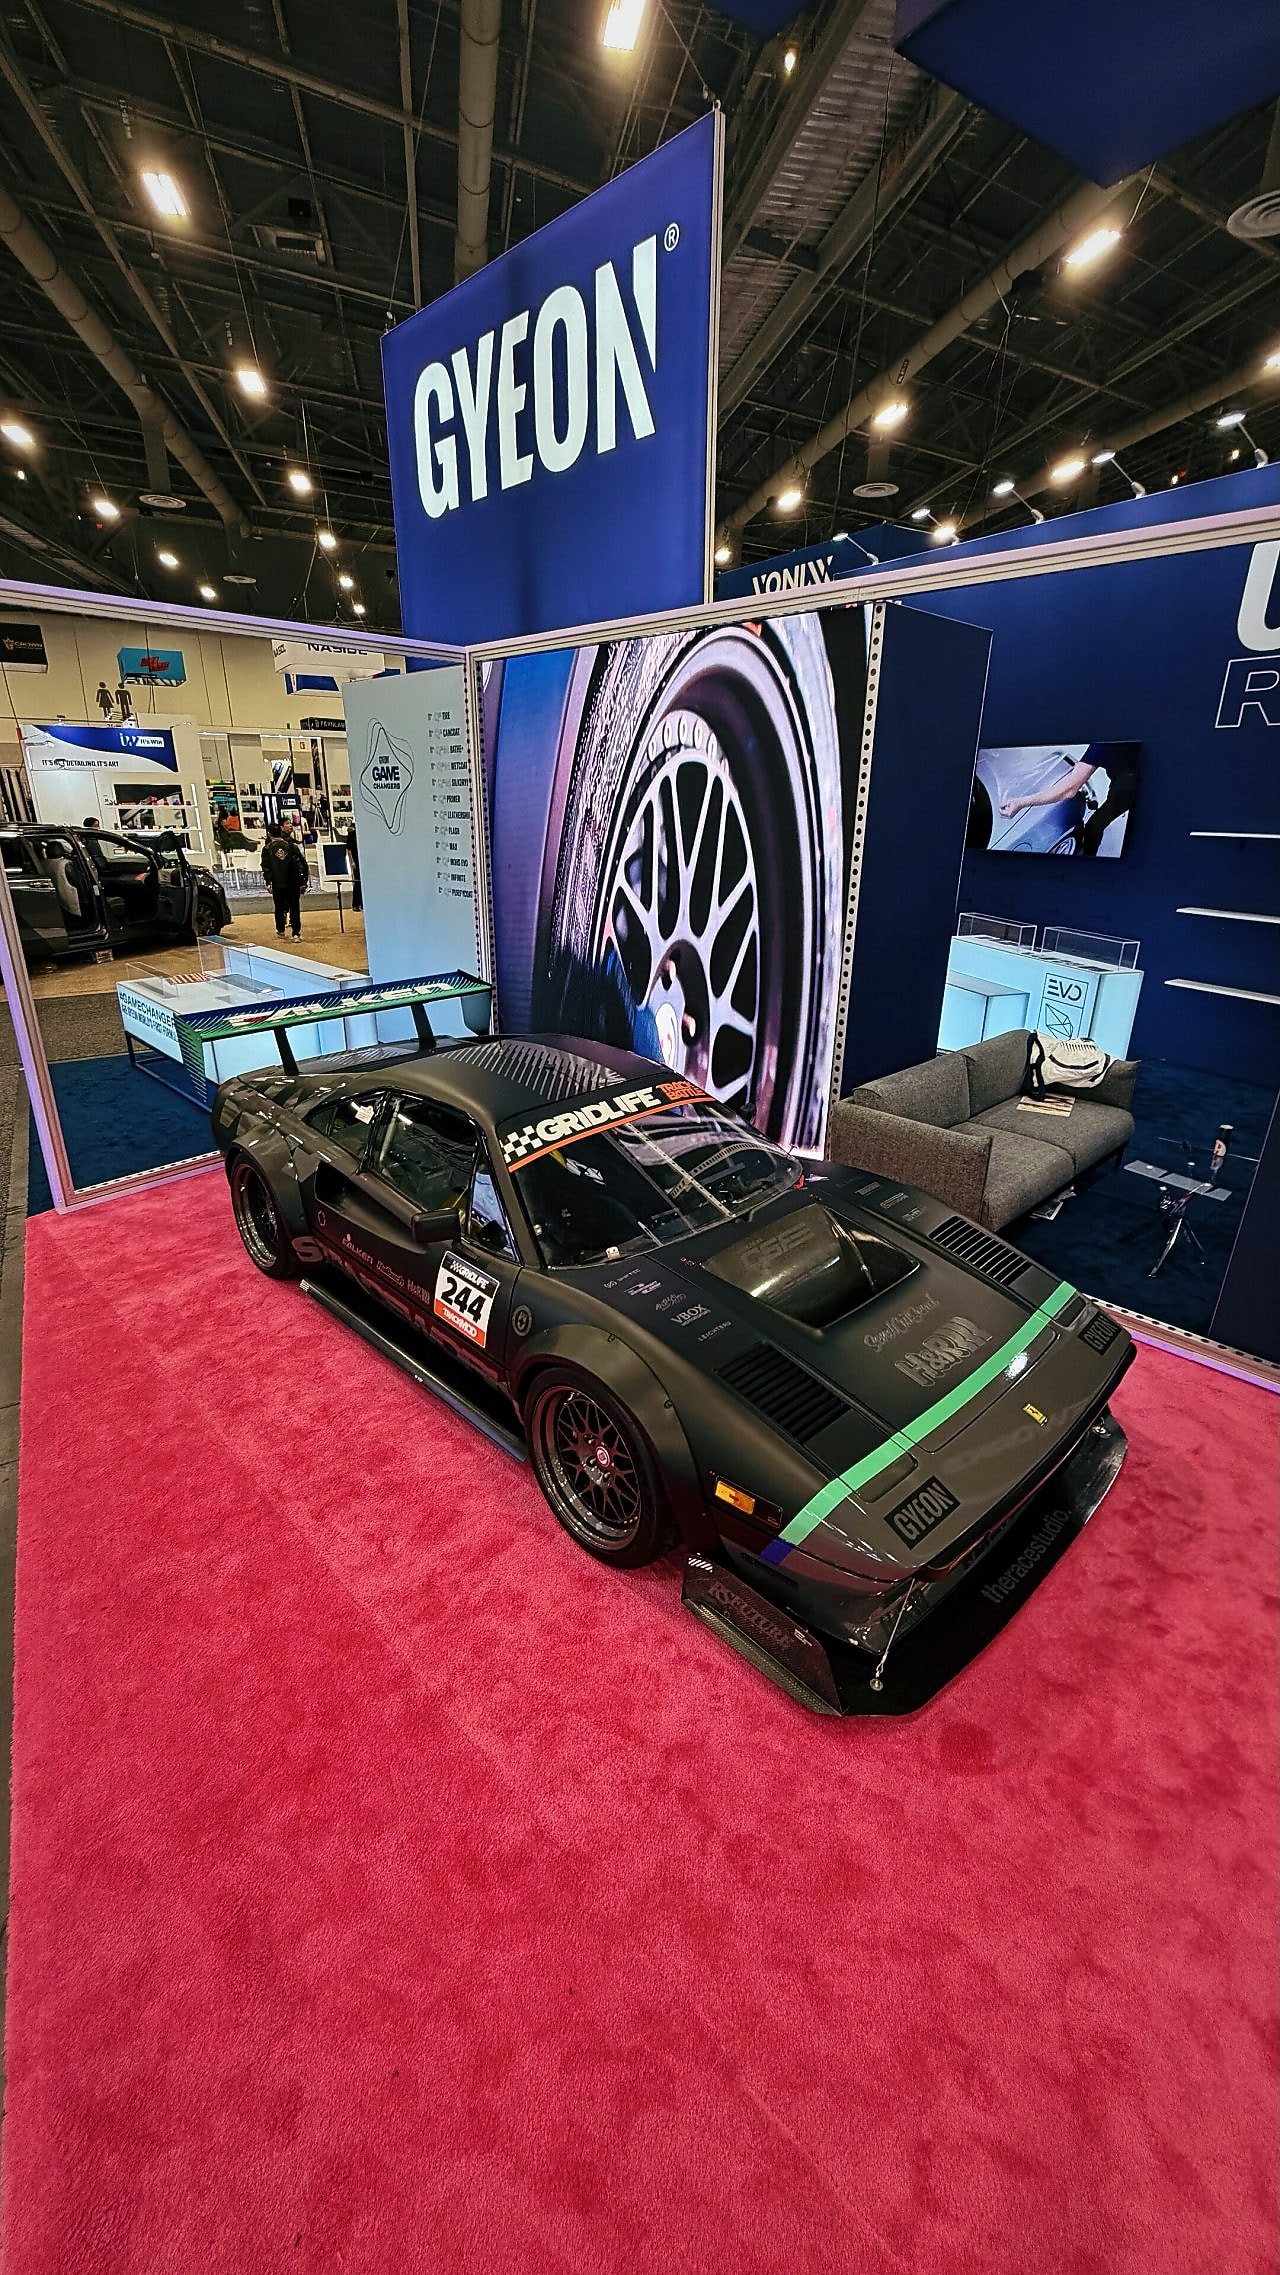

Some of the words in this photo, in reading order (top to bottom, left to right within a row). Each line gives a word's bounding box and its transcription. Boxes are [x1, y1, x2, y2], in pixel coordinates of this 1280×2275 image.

[372, 766, 400, 782] GAME
[373, 782, 401, 790] CHANGERS
[1047, 978, 1082, 1002] EVO
[535, 1086, 662, 1143] GRIDLIFE
[459, 1266, 490, 1290] GRIDLIFE
[440, 1276, 487, 1324] 244
[670, 1303, 707, 1324] VBOX
[893, 1481, 955, 1541] GYEON
